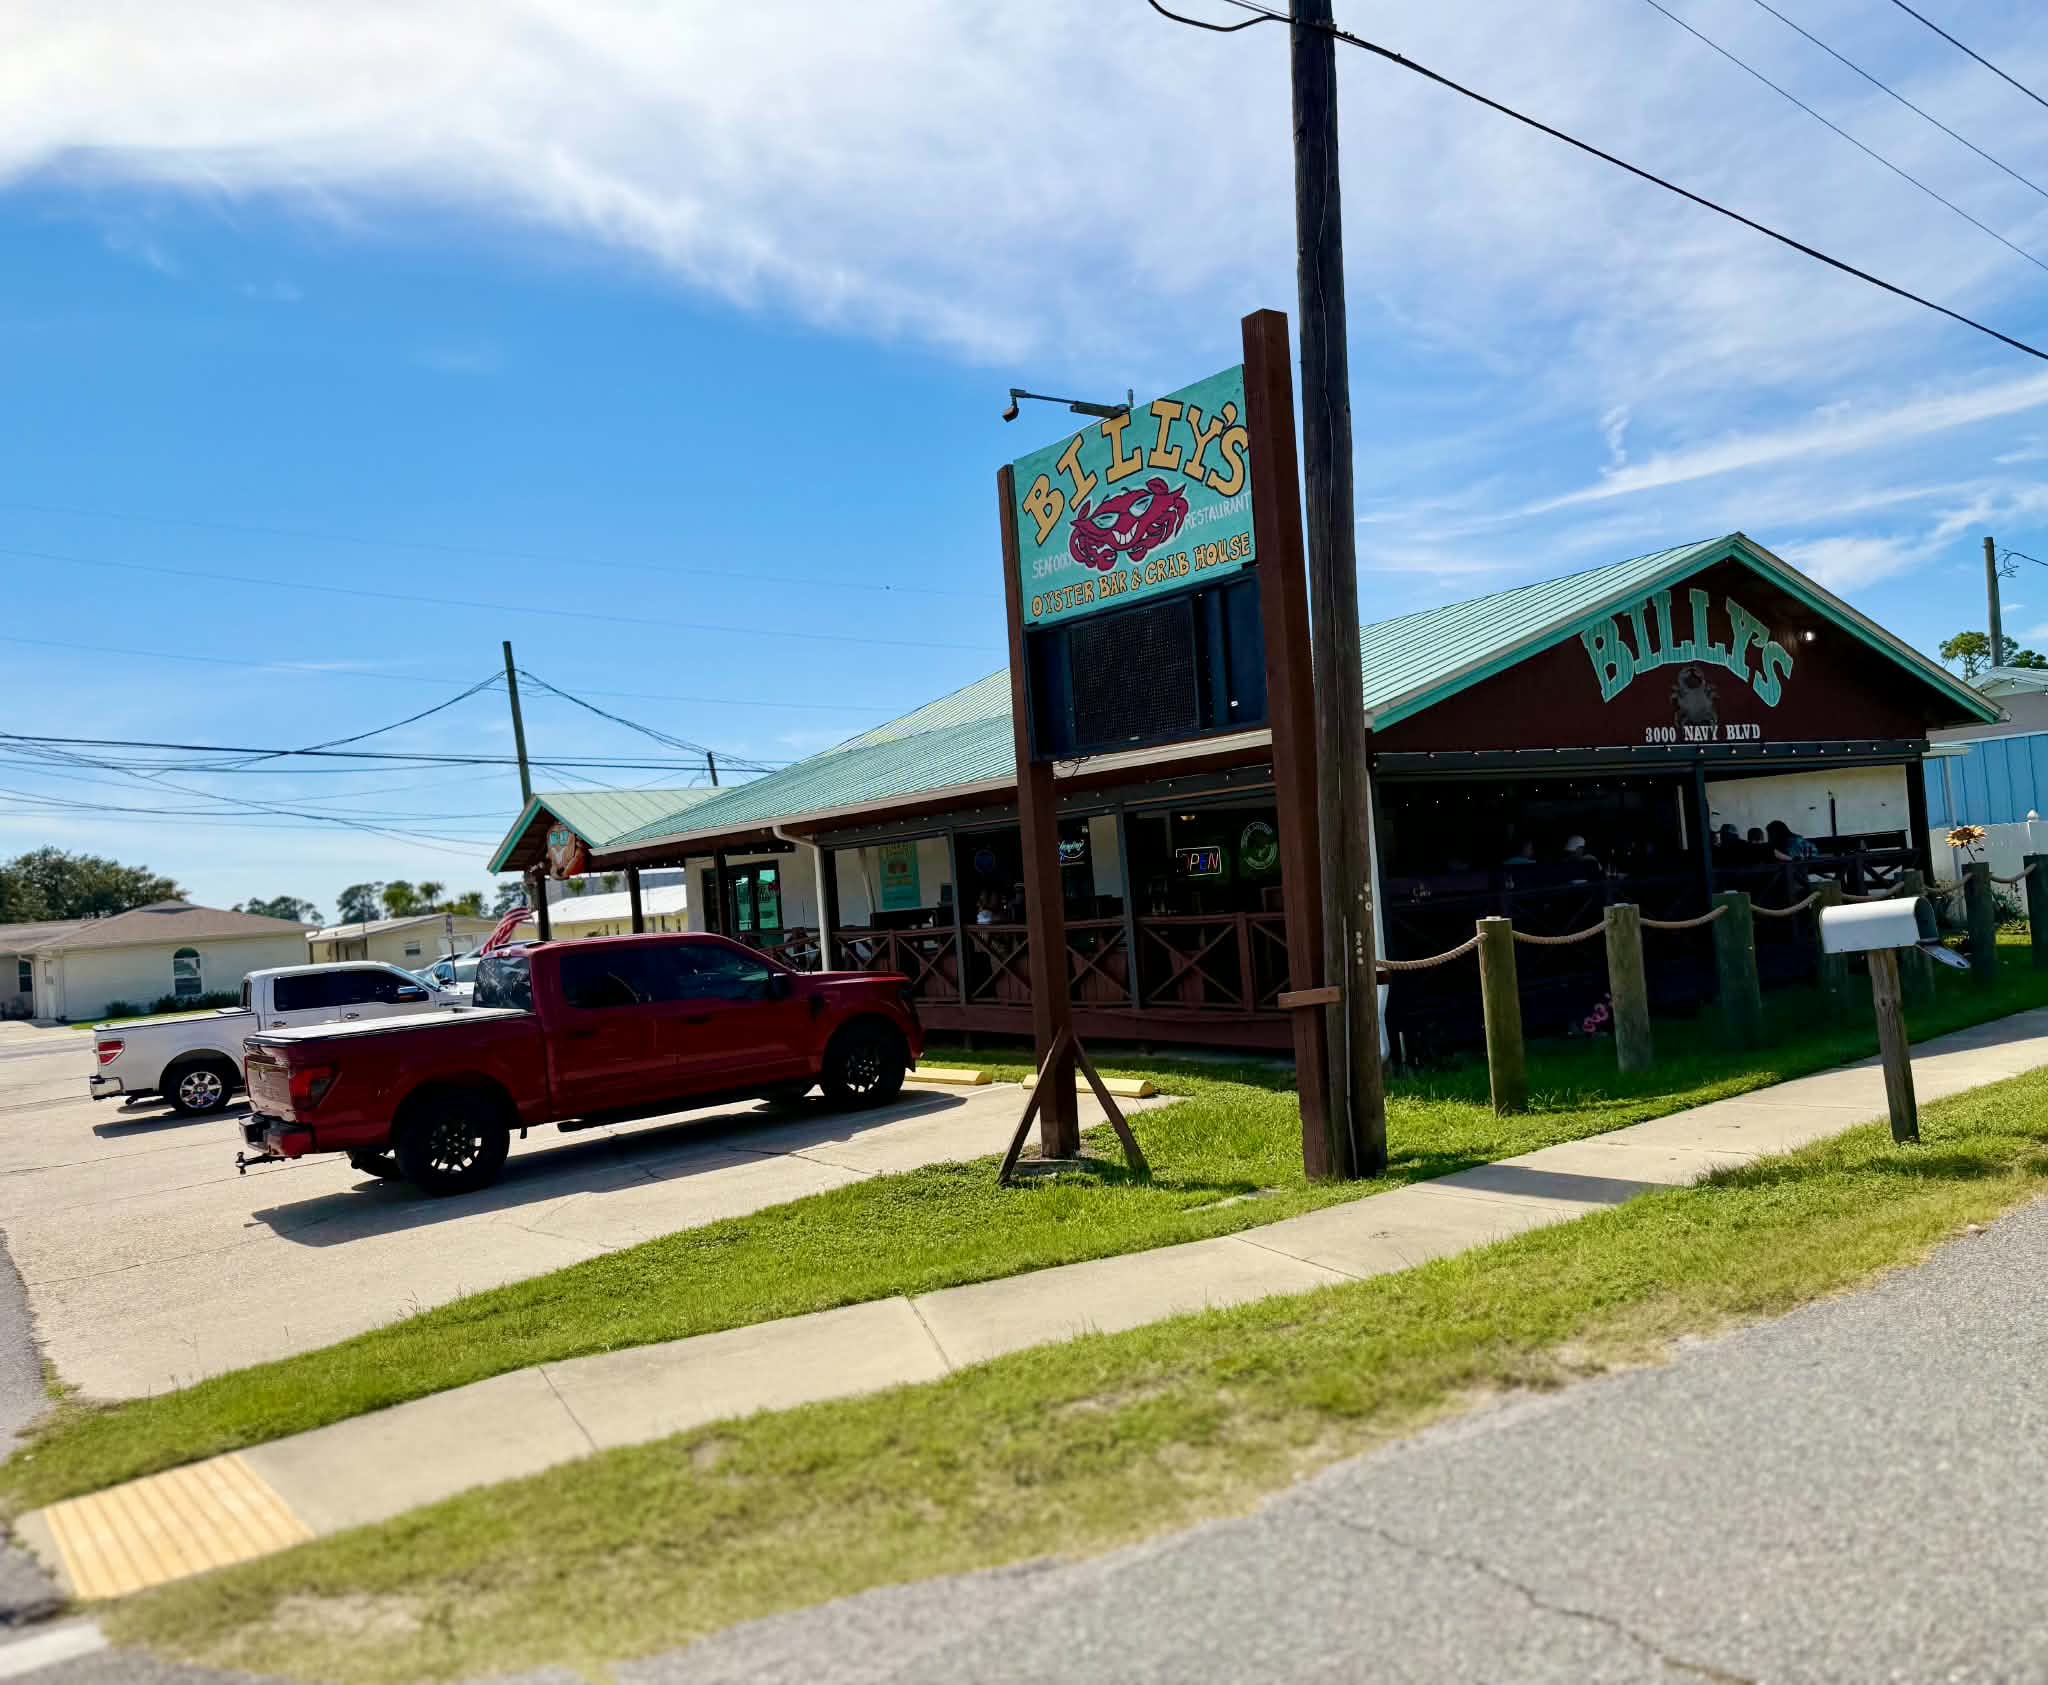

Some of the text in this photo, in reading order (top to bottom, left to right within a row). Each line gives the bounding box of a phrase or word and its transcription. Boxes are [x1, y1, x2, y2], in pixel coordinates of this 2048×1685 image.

[1022, 399, 1250, 546] BILLY'S
[1184, 493, 1250, 529] RESTAURANT
[1031, 531, 1251, 617] OYSTER BAR & CRAB HOUSE
[1579, 588, 1794, 708] BILLY'S
[1645, 724, 1761, 743] 3000 NAVY BLVD
